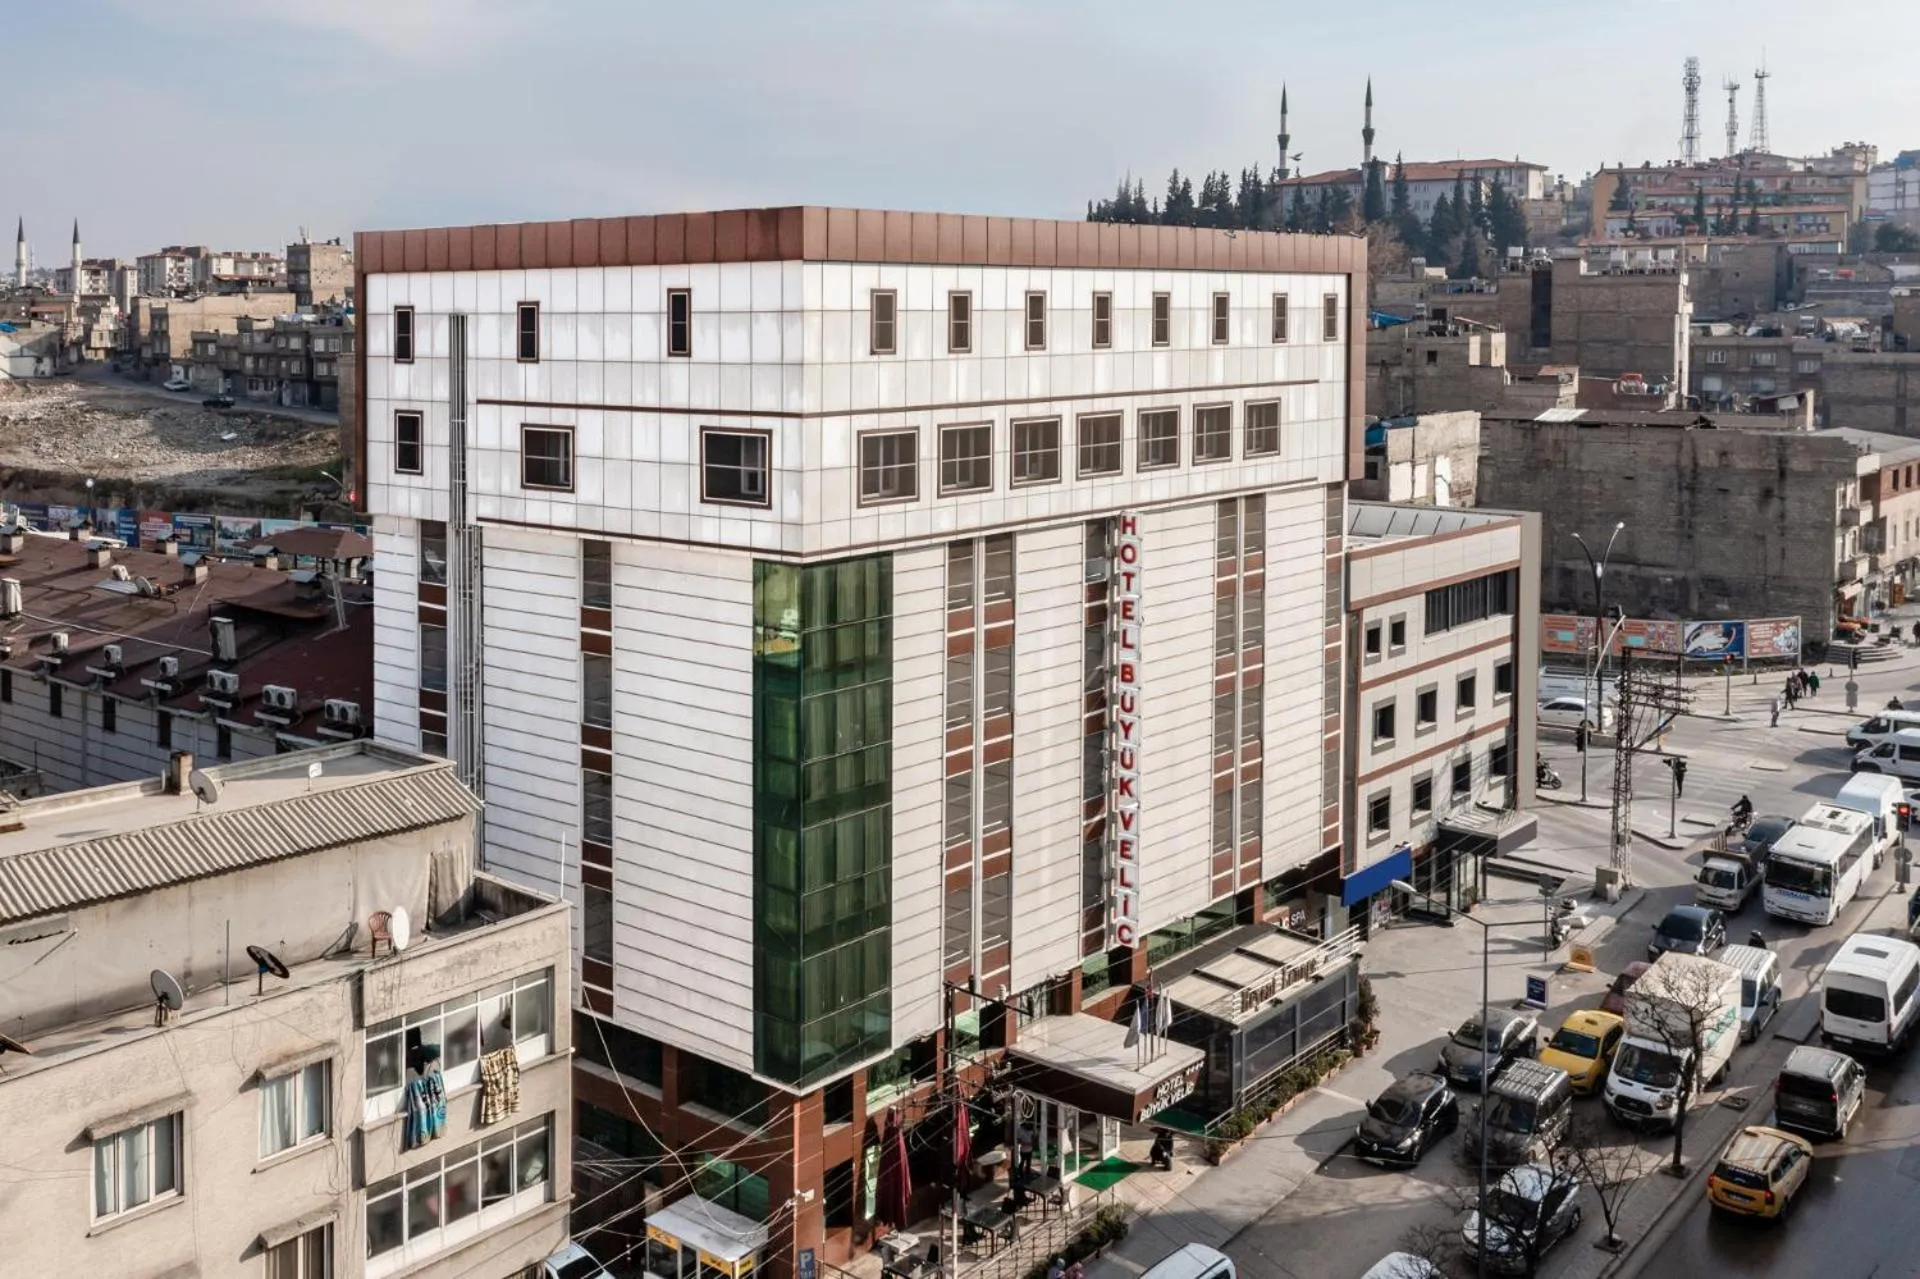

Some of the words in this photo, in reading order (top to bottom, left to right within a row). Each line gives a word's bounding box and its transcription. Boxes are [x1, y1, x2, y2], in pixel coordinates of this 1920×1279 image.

[1120, 515, 1136, 649] HOTEL
[1119, 663, 1135, 798] BÜYÜK
[1117, 810, 1135, 945] VELİC
[1291, 909, 1306, 926] SPA
[1157, 1074, 1184, 1100] HOTEL
[800, 1252, 812, 1269] P
